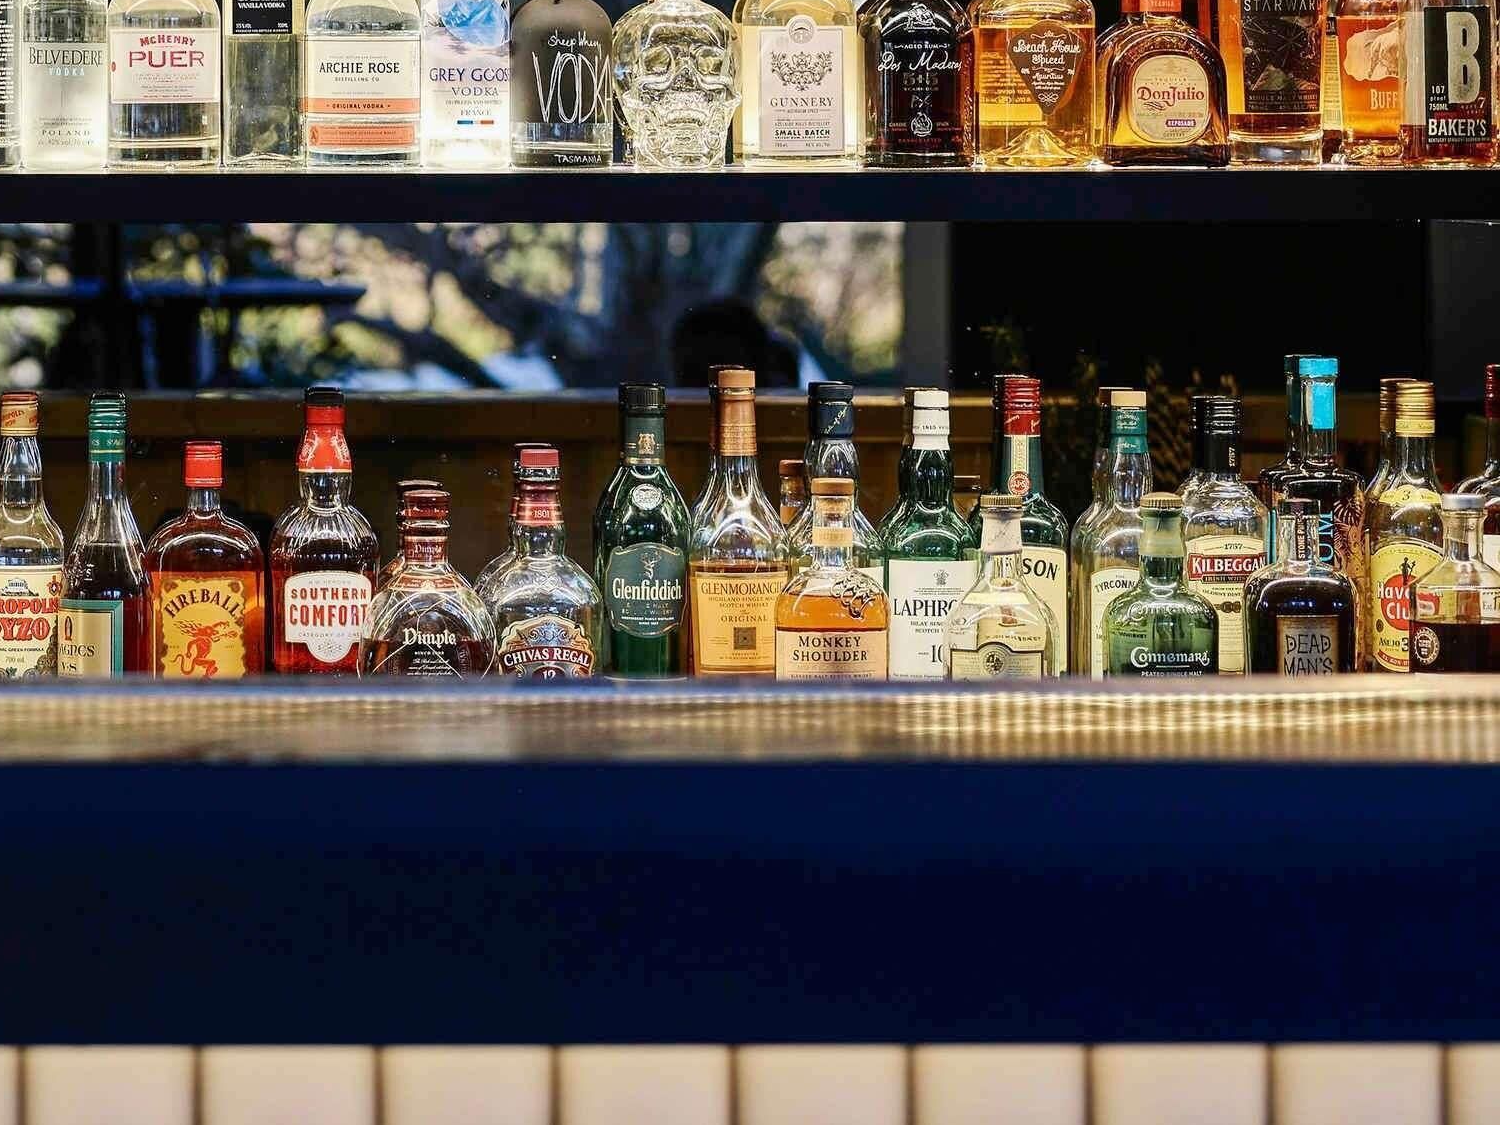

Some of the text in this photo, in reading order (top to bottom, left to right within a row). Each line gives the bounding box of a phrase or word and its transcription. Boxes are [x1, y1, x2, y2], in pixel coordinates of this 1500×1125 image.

[1012, 39, 1048, 54] Beach
[28, 46, 104, 67] BELVEDERE
[128, 50, 205, 68] PUER
[878, 53, 901, 73] Dos
[1031, 54, 1065, 67] Spiced
[1446, 11, 1481, 104] B
[49, 68, 86, 77] VODKA
[319, 62, 400, 74] ARCHIE ROSE
[429, 67, 510, 83] GREY GOOS
[451, 87, 500, 97] VODKA
[531, 50, 613, 125] VODKA
[1431, 86, 1445, 94] 107
[770, 96, 836, 108] GUNNERY
[1370, 88, 1399, 111] BUFF
[1167, 119, 1196, 127] REPOSADO
[1428, 118, 1488, 137] BAKER'S
[555, 153, 603, 165] TASMANIA
[533, 509, 550, 518] 1801
[1191, 555, 1266, 573] KILBEGGAN
[291, 588, 367, 600] SOUTHERN
[612, 577, 683, 601] Glenfiddich
[164, 588, 241, 619] FIREBALL
[893, 597, 957, 617] LAPHRO
[289, 604, 368, 627] COMFORT
[720, 614, 768, 623] ORIGINAL
[402, 627, 457, 648] Dimple
[799, 635, 862, 648] MONKEY
[1284, 633, 1332, 654] DEAD
[504, 648, 590, 668] CHIVAS REGAL
[792, 649, 869, 662] SHOULDER
[1130, 646, 1211, 668] Connemara
